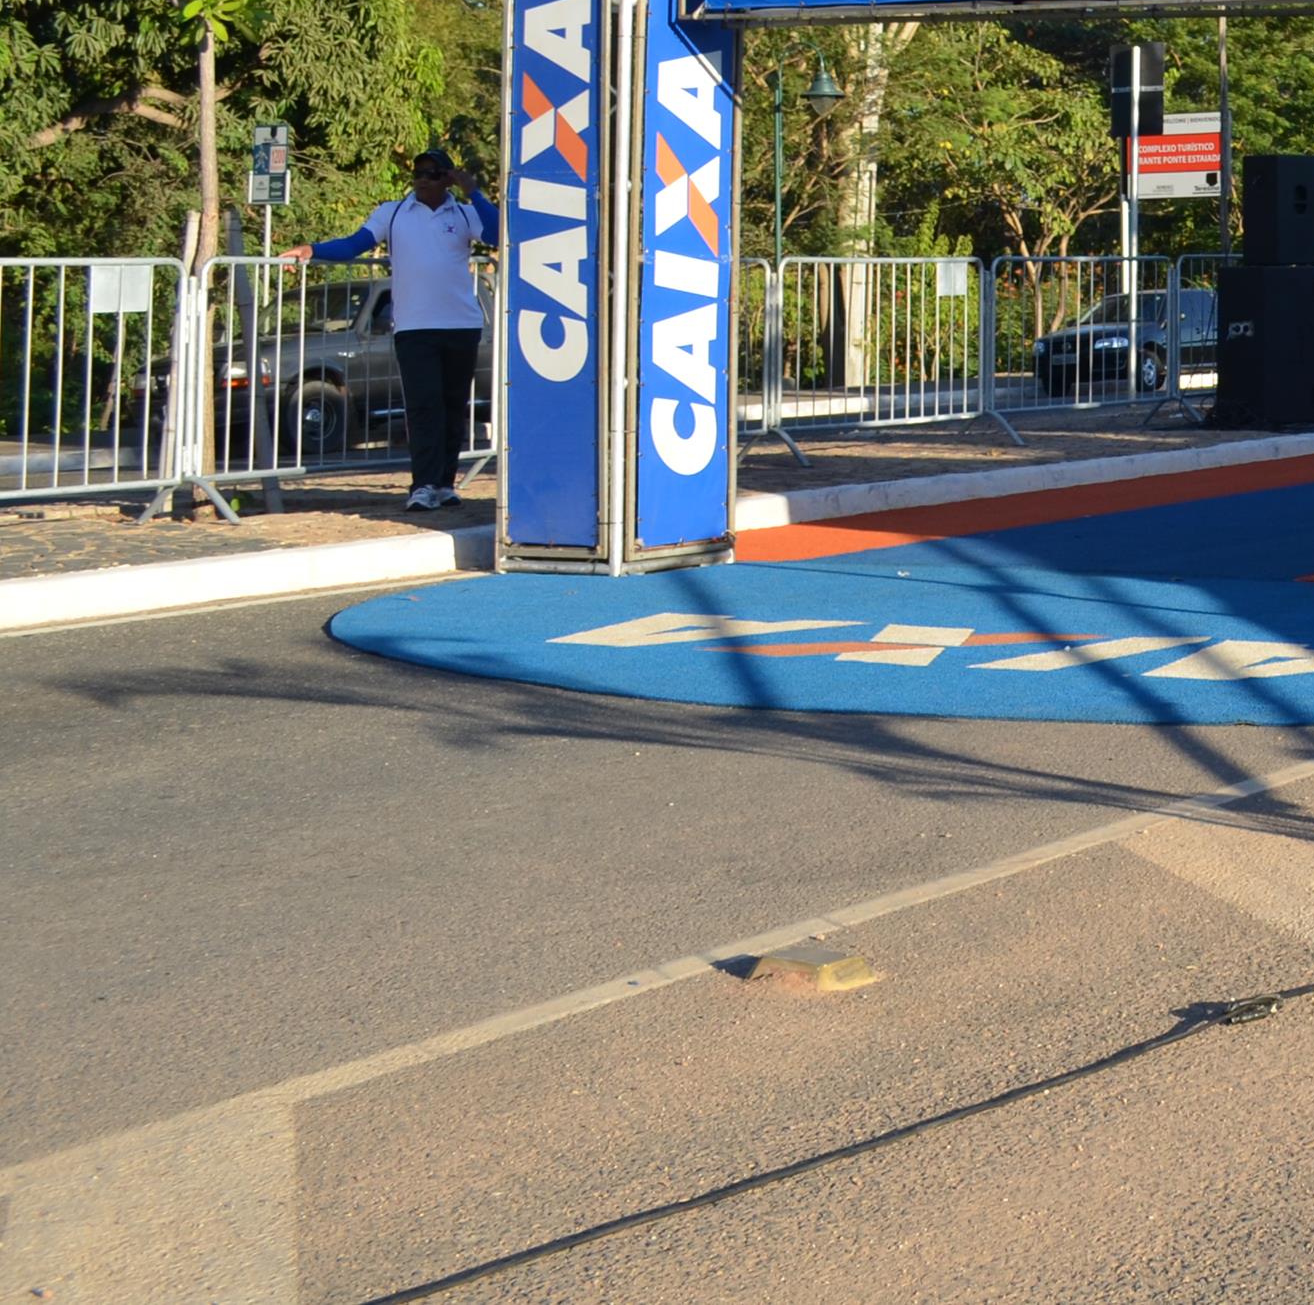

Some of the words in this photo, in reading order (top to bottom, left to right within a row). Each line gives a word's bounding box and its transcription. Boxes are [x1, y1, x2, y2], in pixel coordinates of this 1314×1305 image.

[1138, 145, 1177, 154] COMPLEXO
[1163, 155, 1187, 165] PONTE
[650, 49, 723, 477] CAIXA
